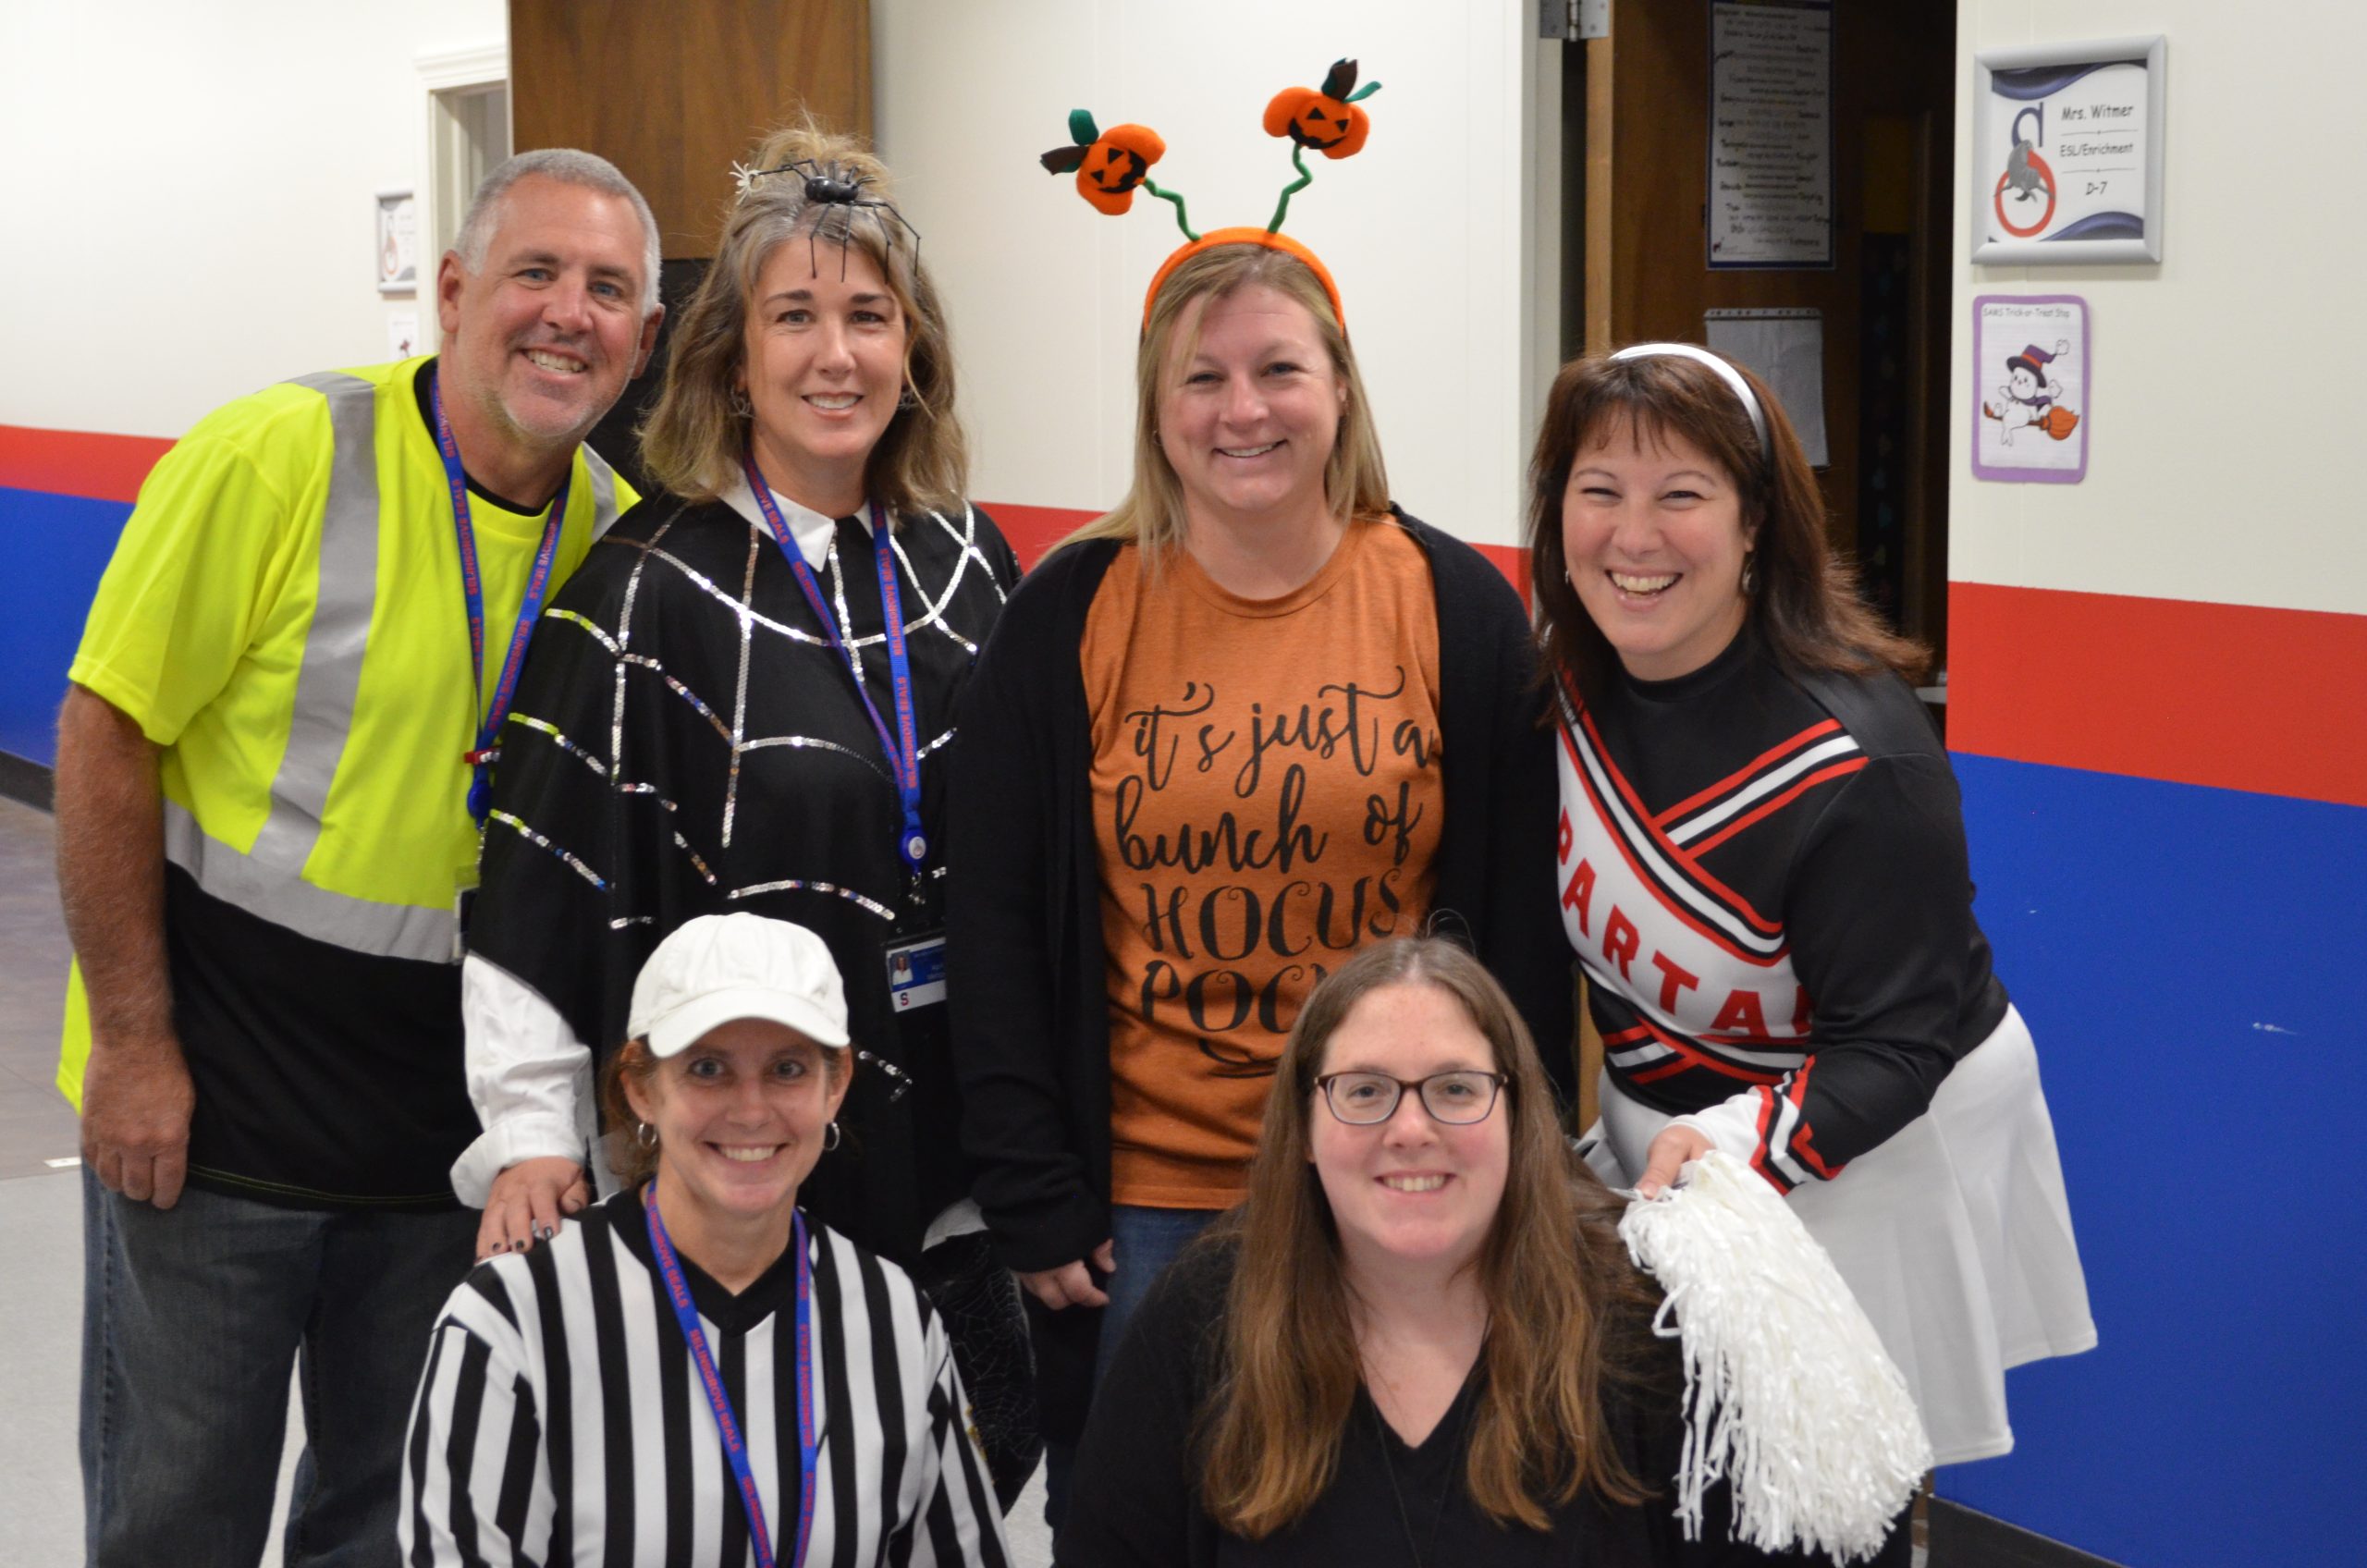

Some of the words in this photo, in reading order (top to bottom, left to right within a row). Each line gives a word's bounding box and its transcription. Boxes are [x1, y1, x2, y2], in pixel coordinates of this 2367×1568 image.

[2061, 106, 2087, 121] Mrs.
[2091, 104, 2134, 119] Witmer
[2060, 142, 2134, 158] ESL/Enrichment
[2085, 181, 2108, 195] D-7
[1124, 681, 1235, 791] it's
[1234, 666, 1405, 798] just
[1392, 718, 1433, 768] a
[1115, 764, 1329, 875] bunch
[1363, 781, 1424, 865] of
[1140, 868, 1402, 961] HOCUS
[1141, 960, 1329, 1034] POC
